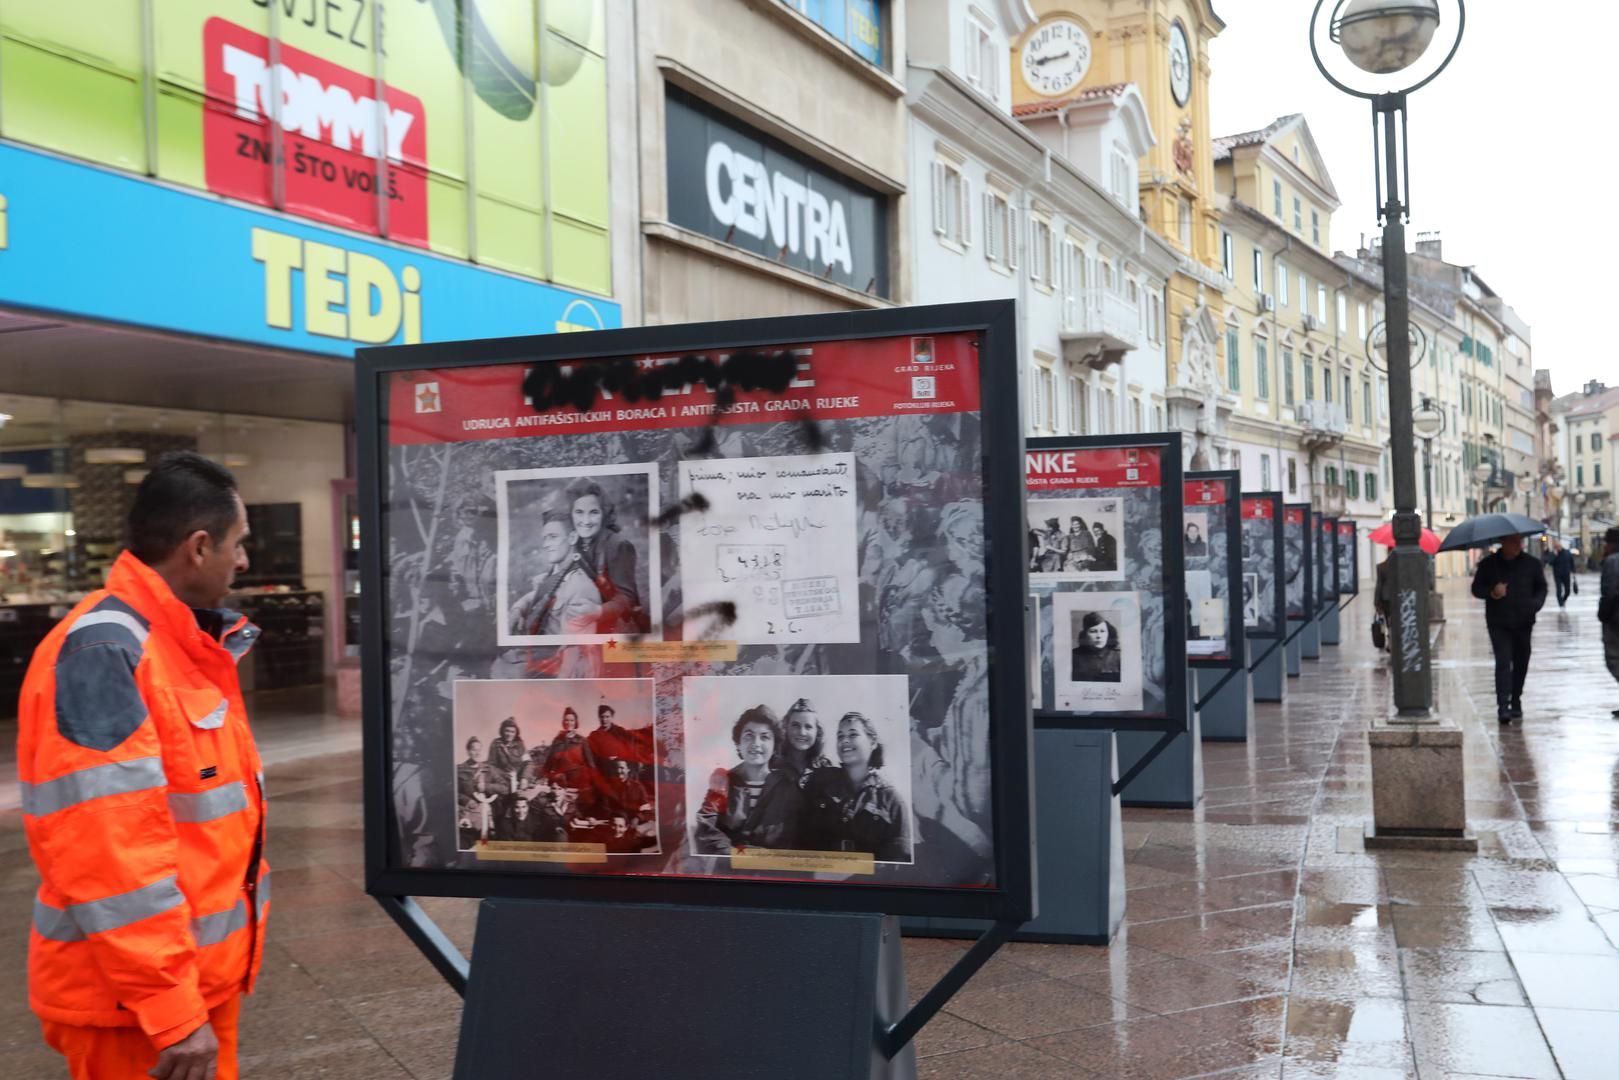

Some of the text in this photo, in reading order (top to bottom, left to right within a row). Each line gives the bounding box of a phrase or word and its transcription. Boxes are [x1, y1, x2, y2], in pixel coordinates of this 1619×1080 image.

[223, 44, 413, 166] TOMMY
[294, 143, 337, 183] ŠTO
[705, 141, 853, 275] CENTRA
[252, 228, 421, 345] TEDi
[463, 417, 511, 431] UDRUGA
[616, 405, 668, 421] BORACA
[671, 405, 677, 418] I
[764, 398, 811, 412] GRADA
[816, 395, 860, 409] RIJEKE
